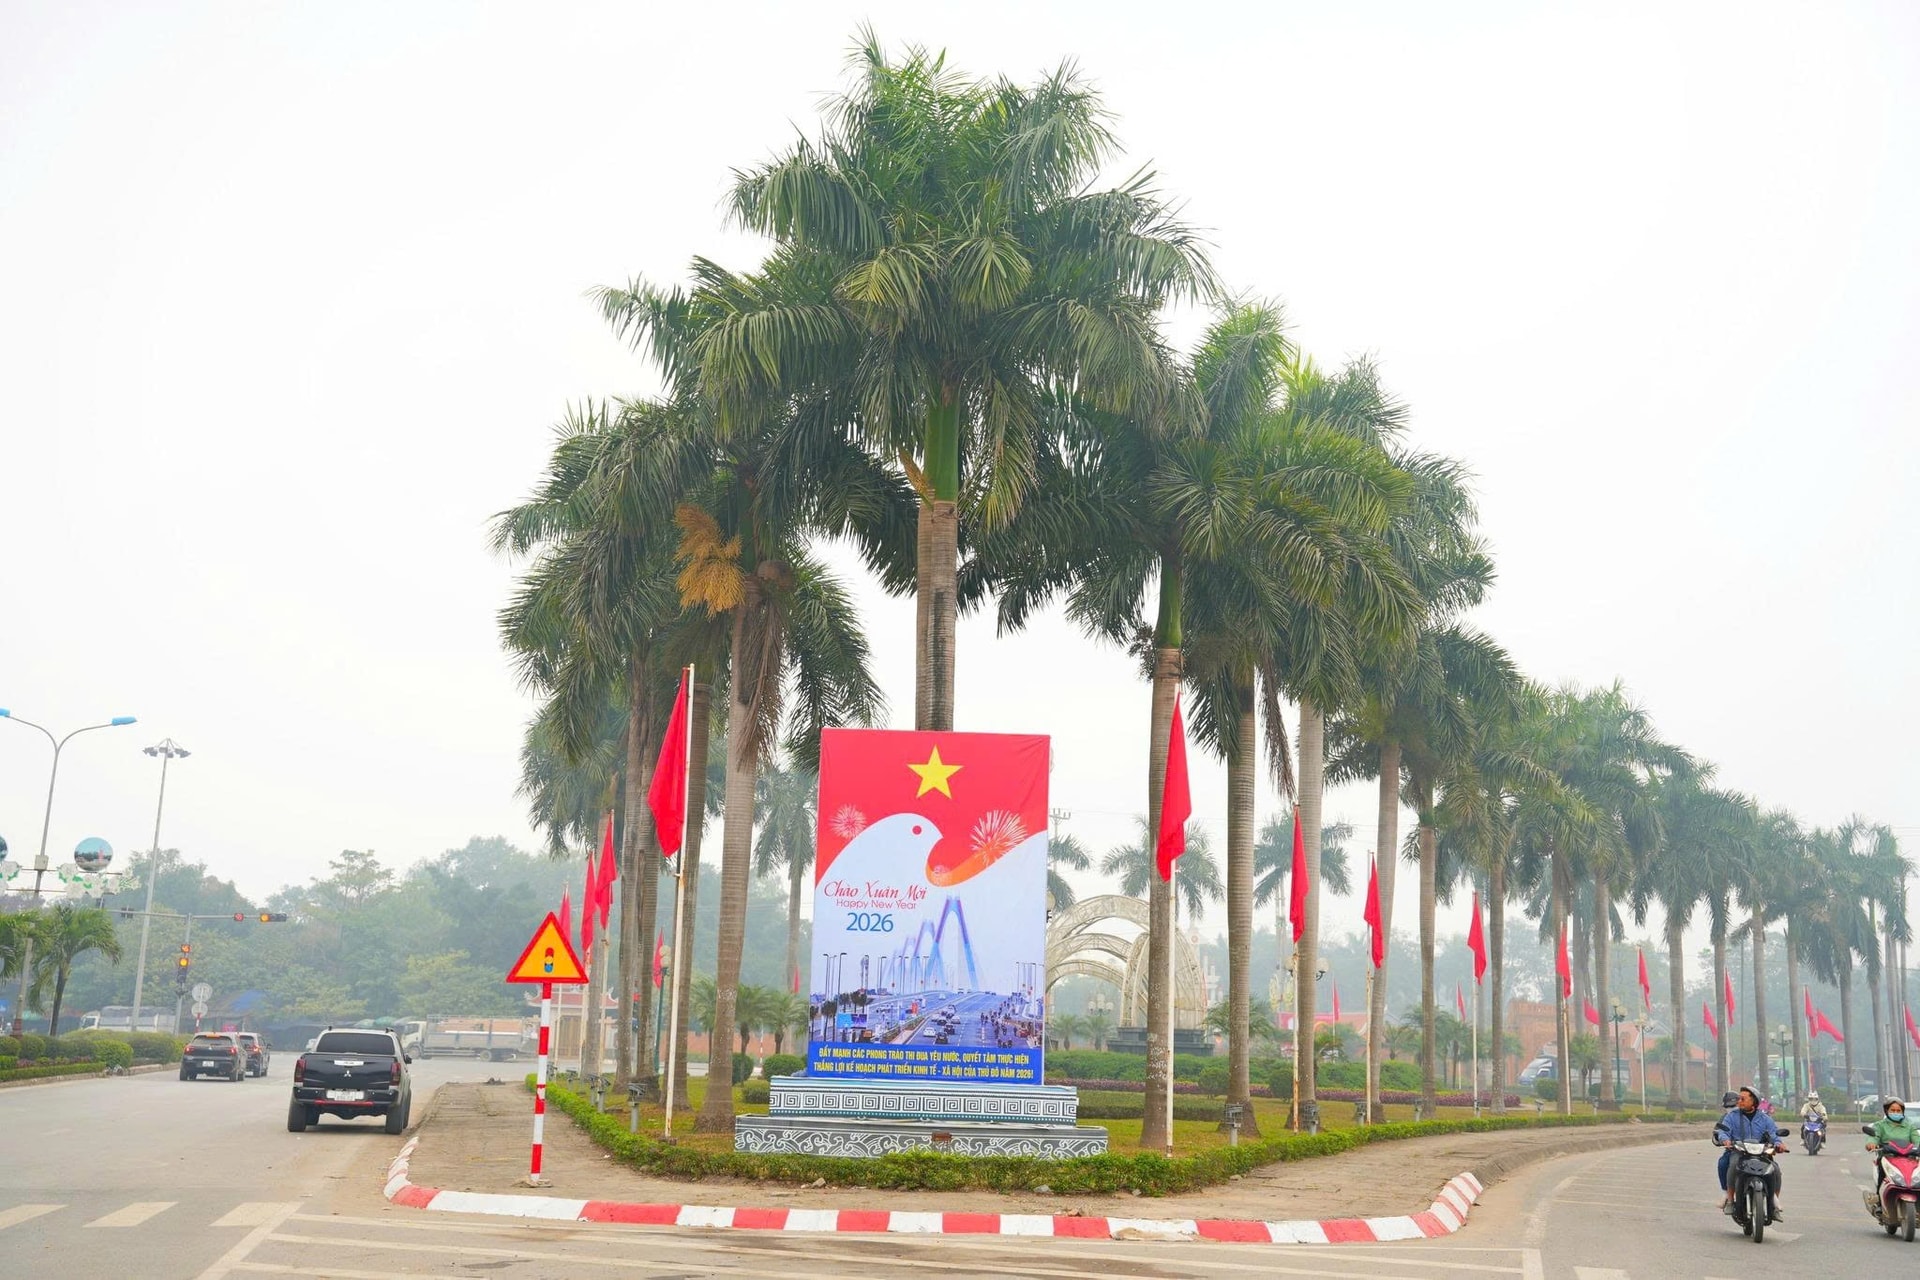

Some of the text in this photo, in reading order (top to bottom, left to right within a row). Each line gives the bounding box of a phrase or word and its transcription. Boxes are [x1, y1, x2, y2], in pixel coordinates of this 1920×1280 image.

[824, 880, 859, 897] Chào
[863, 880, 899, 898] Xuân
[836, 899, 917, 910] Happy New Year
[846, 912, 894, 932] 2026
[833, 1048, 851, 1059] MẠNH
[852, 1047, 865, 1058] CÁC
[866, 1049, 887, 1059] PHONG
[888, 1049, 904, 1059] TRÀO
[905, 1051, 915, 1060] THI
[916, 1051, 928, 1060] ĐUA
[930, 1050, 941, 1061] YÊU
[963, 1051, 981, 1063] QUYẾT
[983, 1052, 996, 1063] TÂM
[998, 1054, 1013, 1065] THỰC
[1014, 1053, 1029, 1066] HIỆN
[814, 1059, 834, 1071] THẮNG
[835, 1062, 844, 1073] LỢI
[846, 1061, 855, 1072] KẾ
[856, 1063, 876, 1075] HOẠCH
[877, 1062, 893, 1073] PHÁT
[895, 1061, 912, 1074] TRIỂN
[913, 1065, 928, 1075] KINH
[930, 1063, 937, 1075] TẾ
[942, 1065, 950, 1075] XÃ
[951, 1065, 962, 1078] HỘI
[963, 1064, 976, 1076] CỦA
[978, 1065, 989, 1077] THỦ
[991, 1067, 999, 1077] ĐÔ
[1000, 1067, 1015, 1077] NĂM
[1016, 1069, 1033, 1078] 2026!
